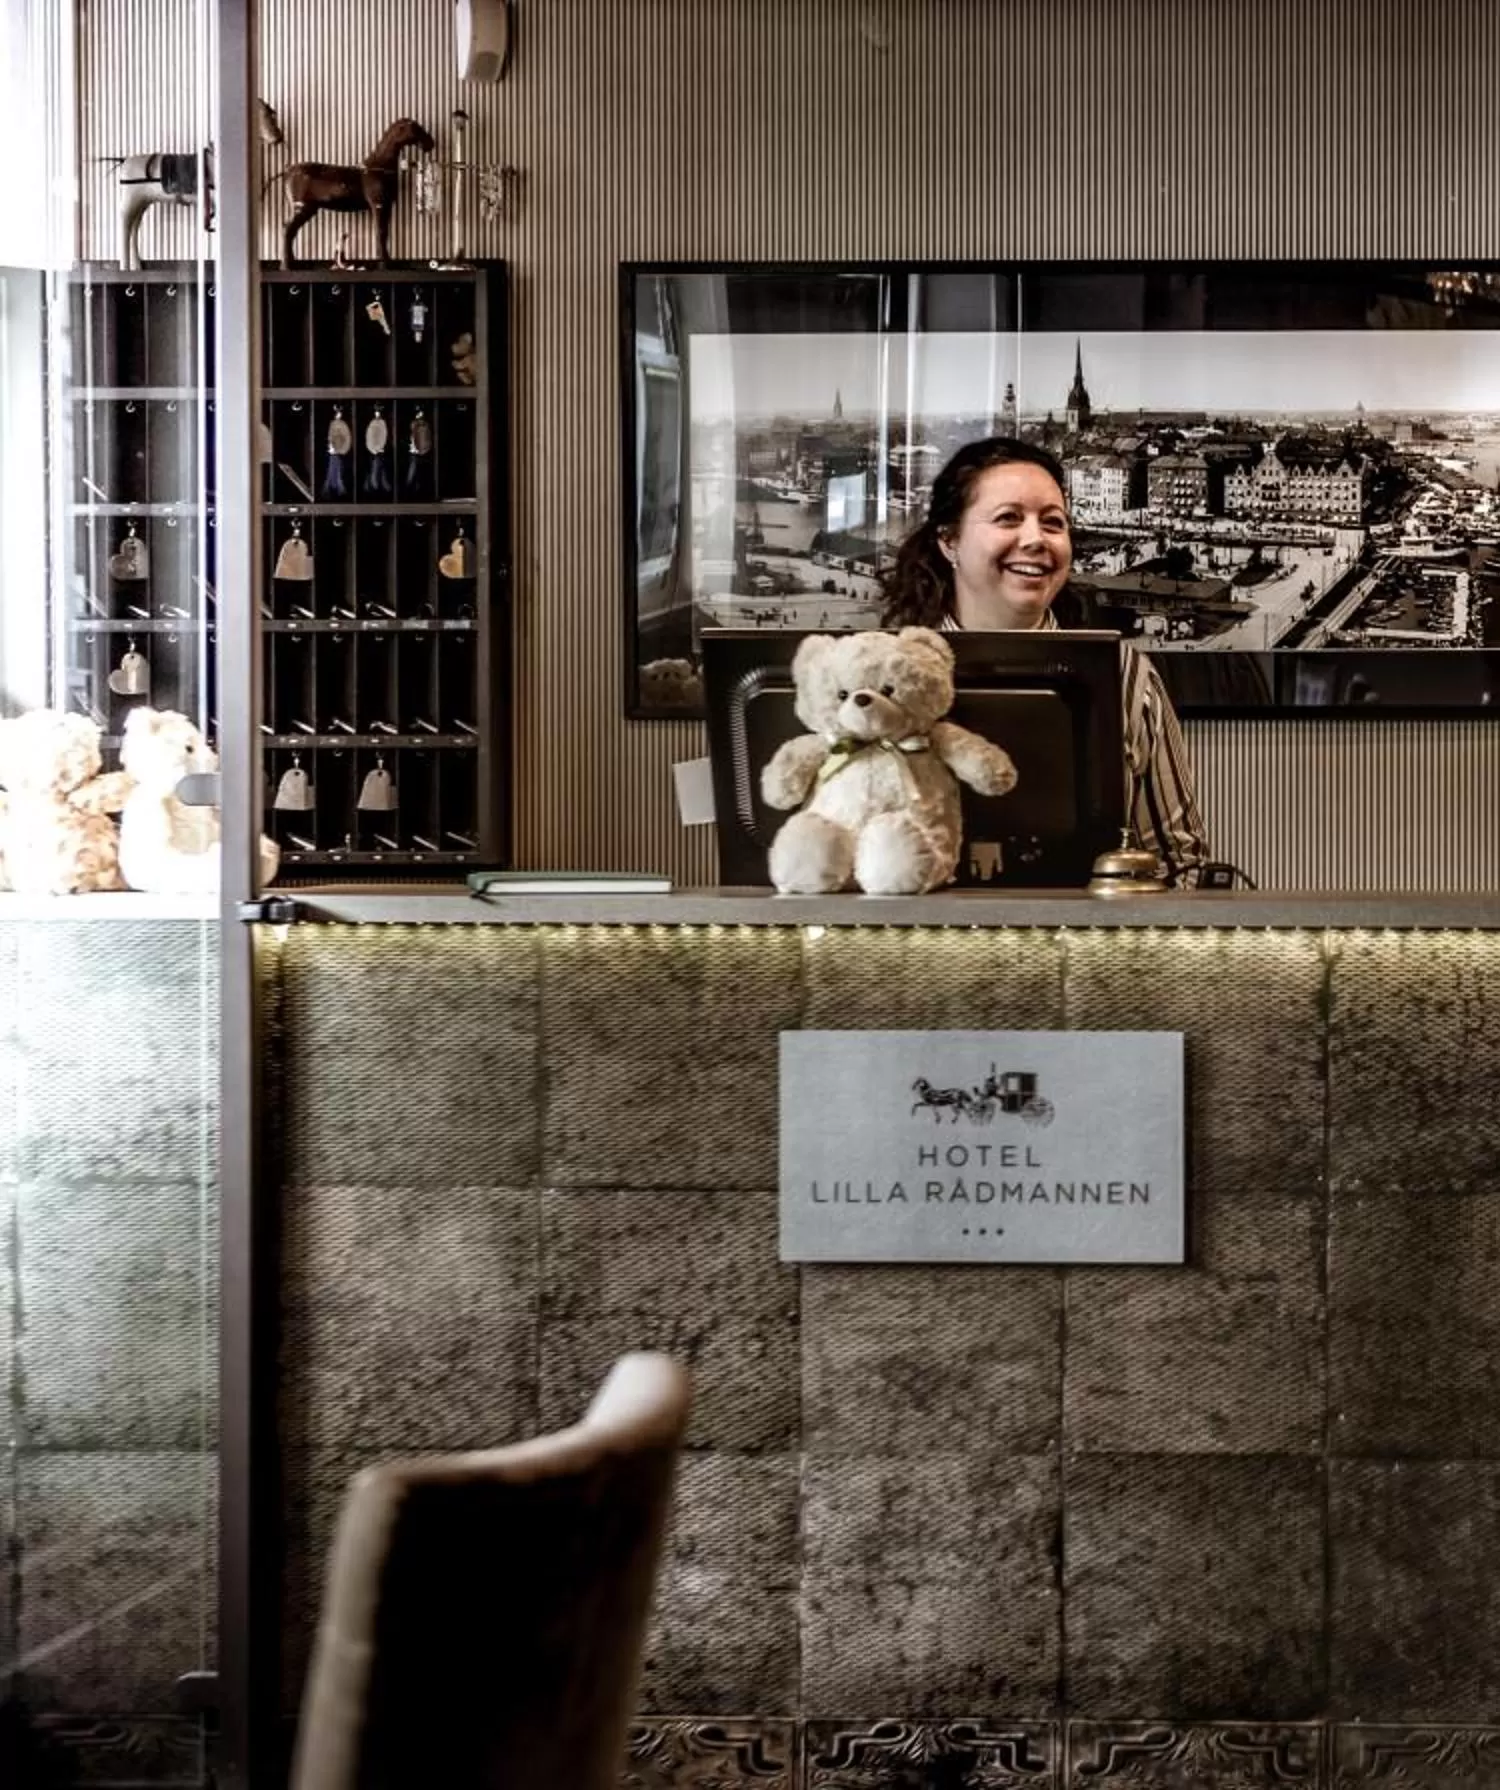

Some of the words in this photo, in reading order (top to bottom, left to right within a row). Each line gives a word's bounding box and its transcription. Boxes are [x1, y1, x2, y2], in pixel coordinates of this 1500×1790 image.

[918, 1145, 1042, 1167] HOTEL
[811, 1180, 908, 1203] LILLA
[925, 1176, 1150, 1204] RÅDMANNEN
